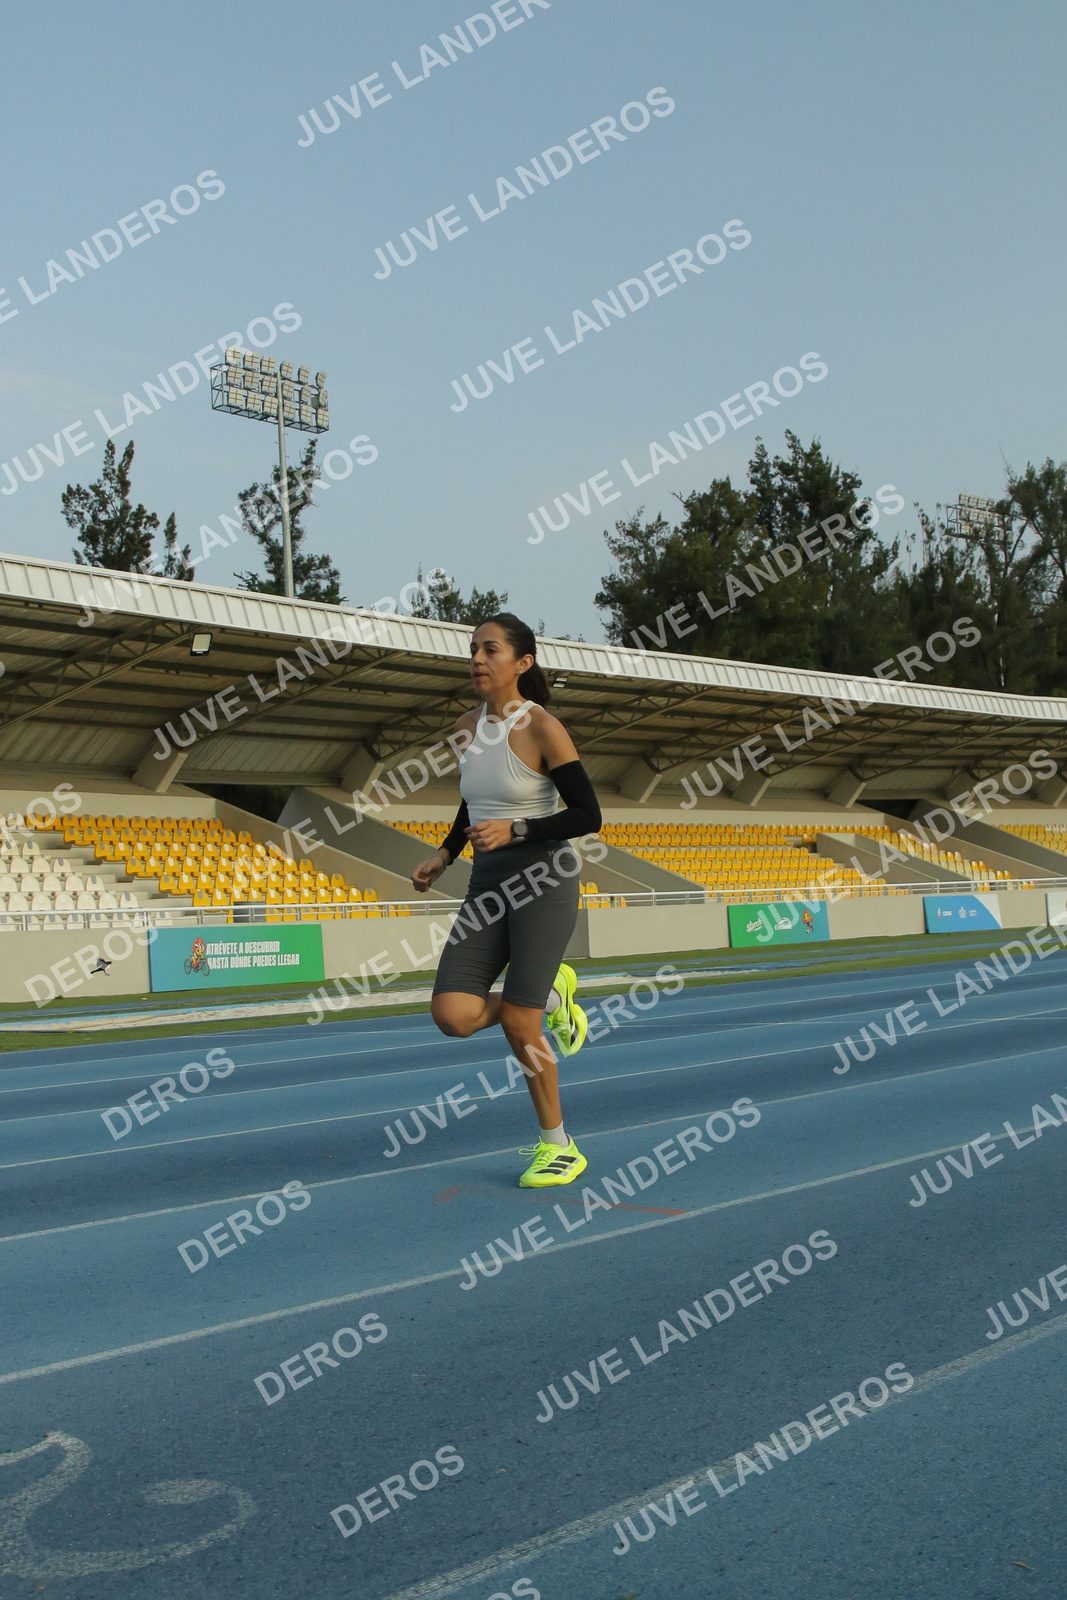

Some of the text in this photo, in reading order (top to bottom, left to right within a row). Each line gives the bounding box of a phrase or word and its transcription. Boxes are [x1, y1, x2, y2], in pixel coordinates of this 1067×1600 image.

[238, 942, 244, 954] A
[252, 954, 277, 967] PUEDES
[277, 953, 300, 966] LLEGAR
